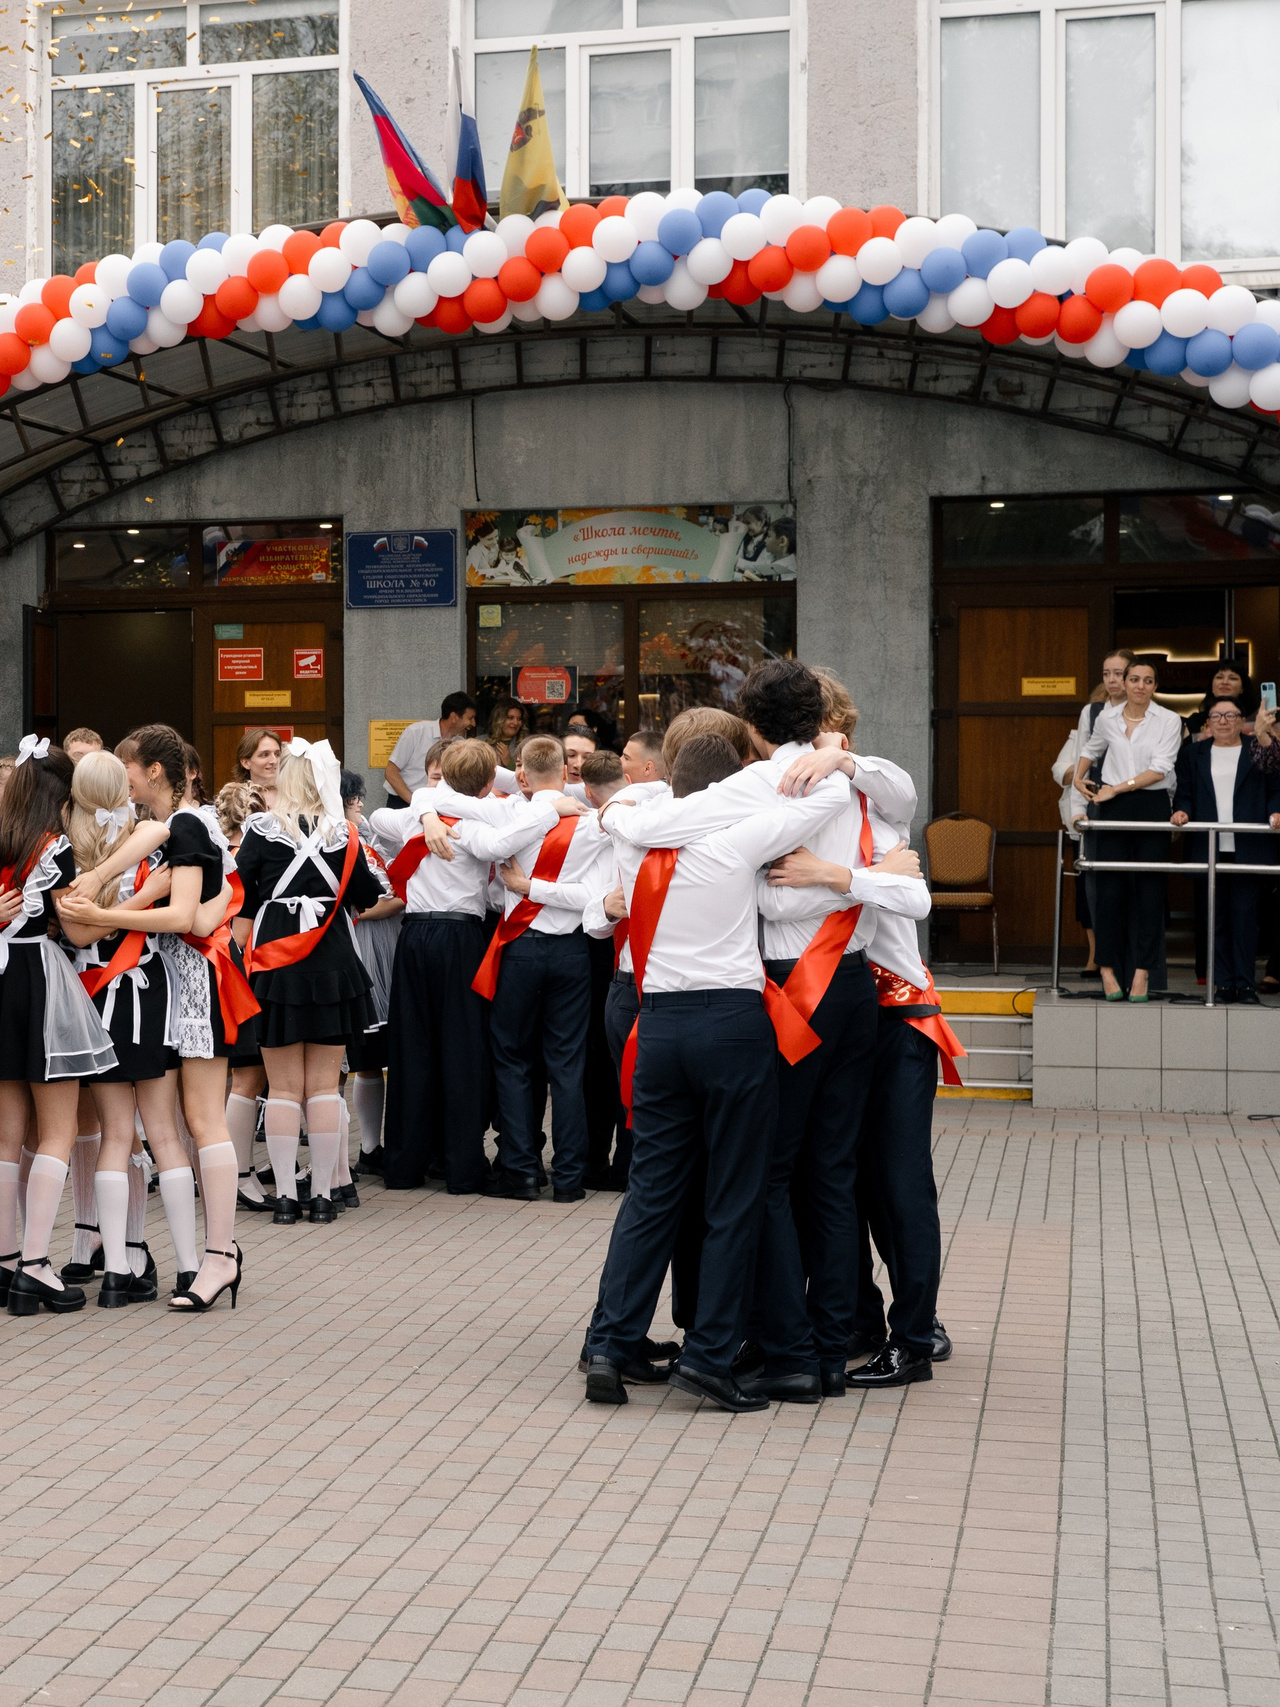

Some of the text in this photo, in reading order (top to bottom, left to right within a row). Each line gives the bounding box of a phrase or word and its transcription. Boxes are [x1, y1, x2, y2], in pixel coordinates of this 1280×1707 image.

[573, 526, 681, 542] «Школа мечты,
[266, 544, 320, 552] УЧАСТКОВАЯ
[567, 544, 699, 565] надежды и свершений!»
[366, 580, 405, 588] ШКОЛА
[422, 579, 436, 587] 40
